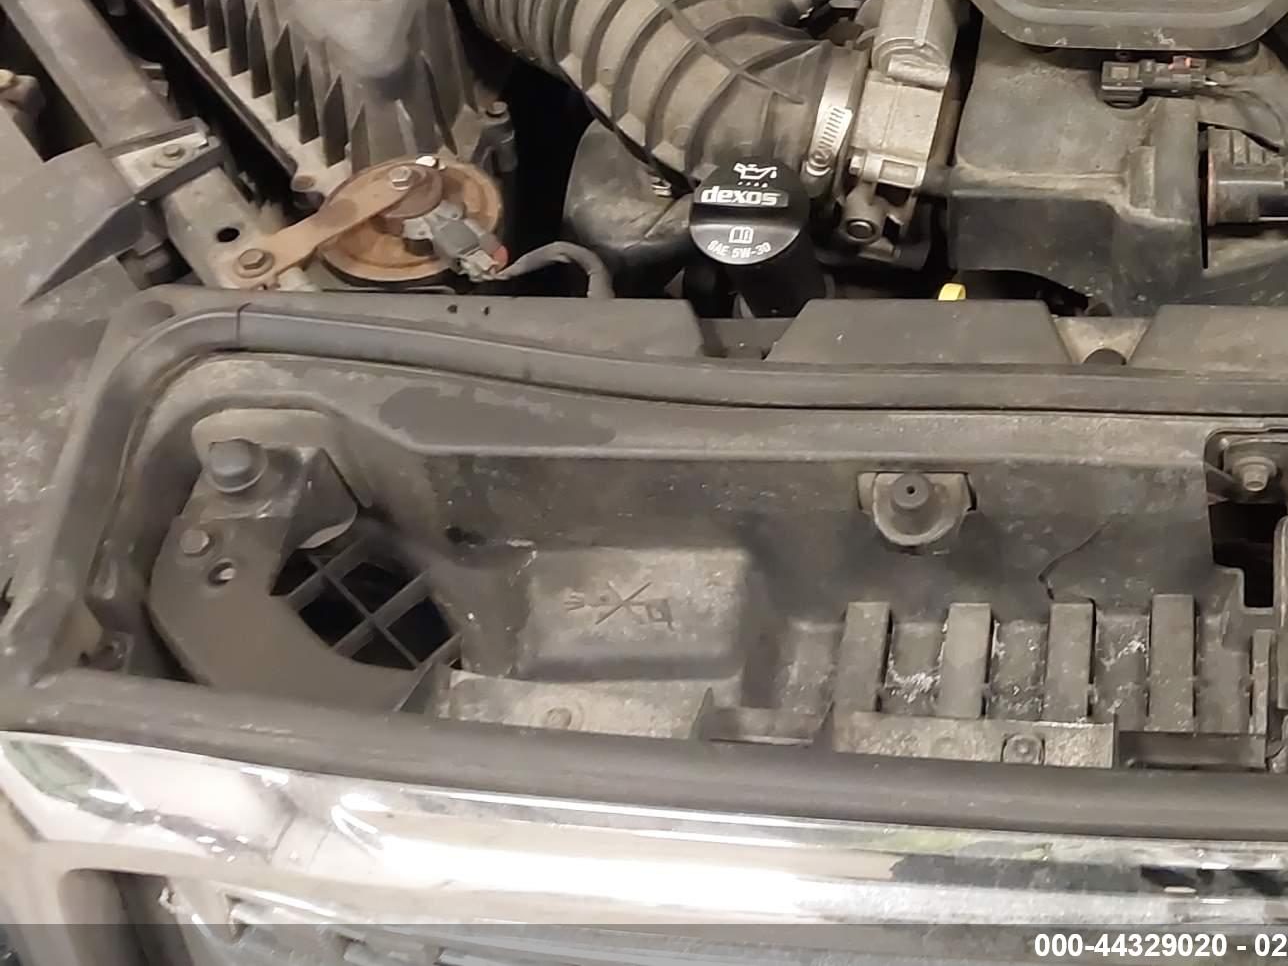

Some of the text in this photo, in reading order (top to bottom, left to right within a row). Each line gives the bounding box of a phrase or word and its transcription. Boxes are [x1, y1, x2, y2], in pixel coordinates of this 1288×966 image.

[701, 185, 782, 206] dexos
[707, 240, 771, 259] SAE 5W-30
